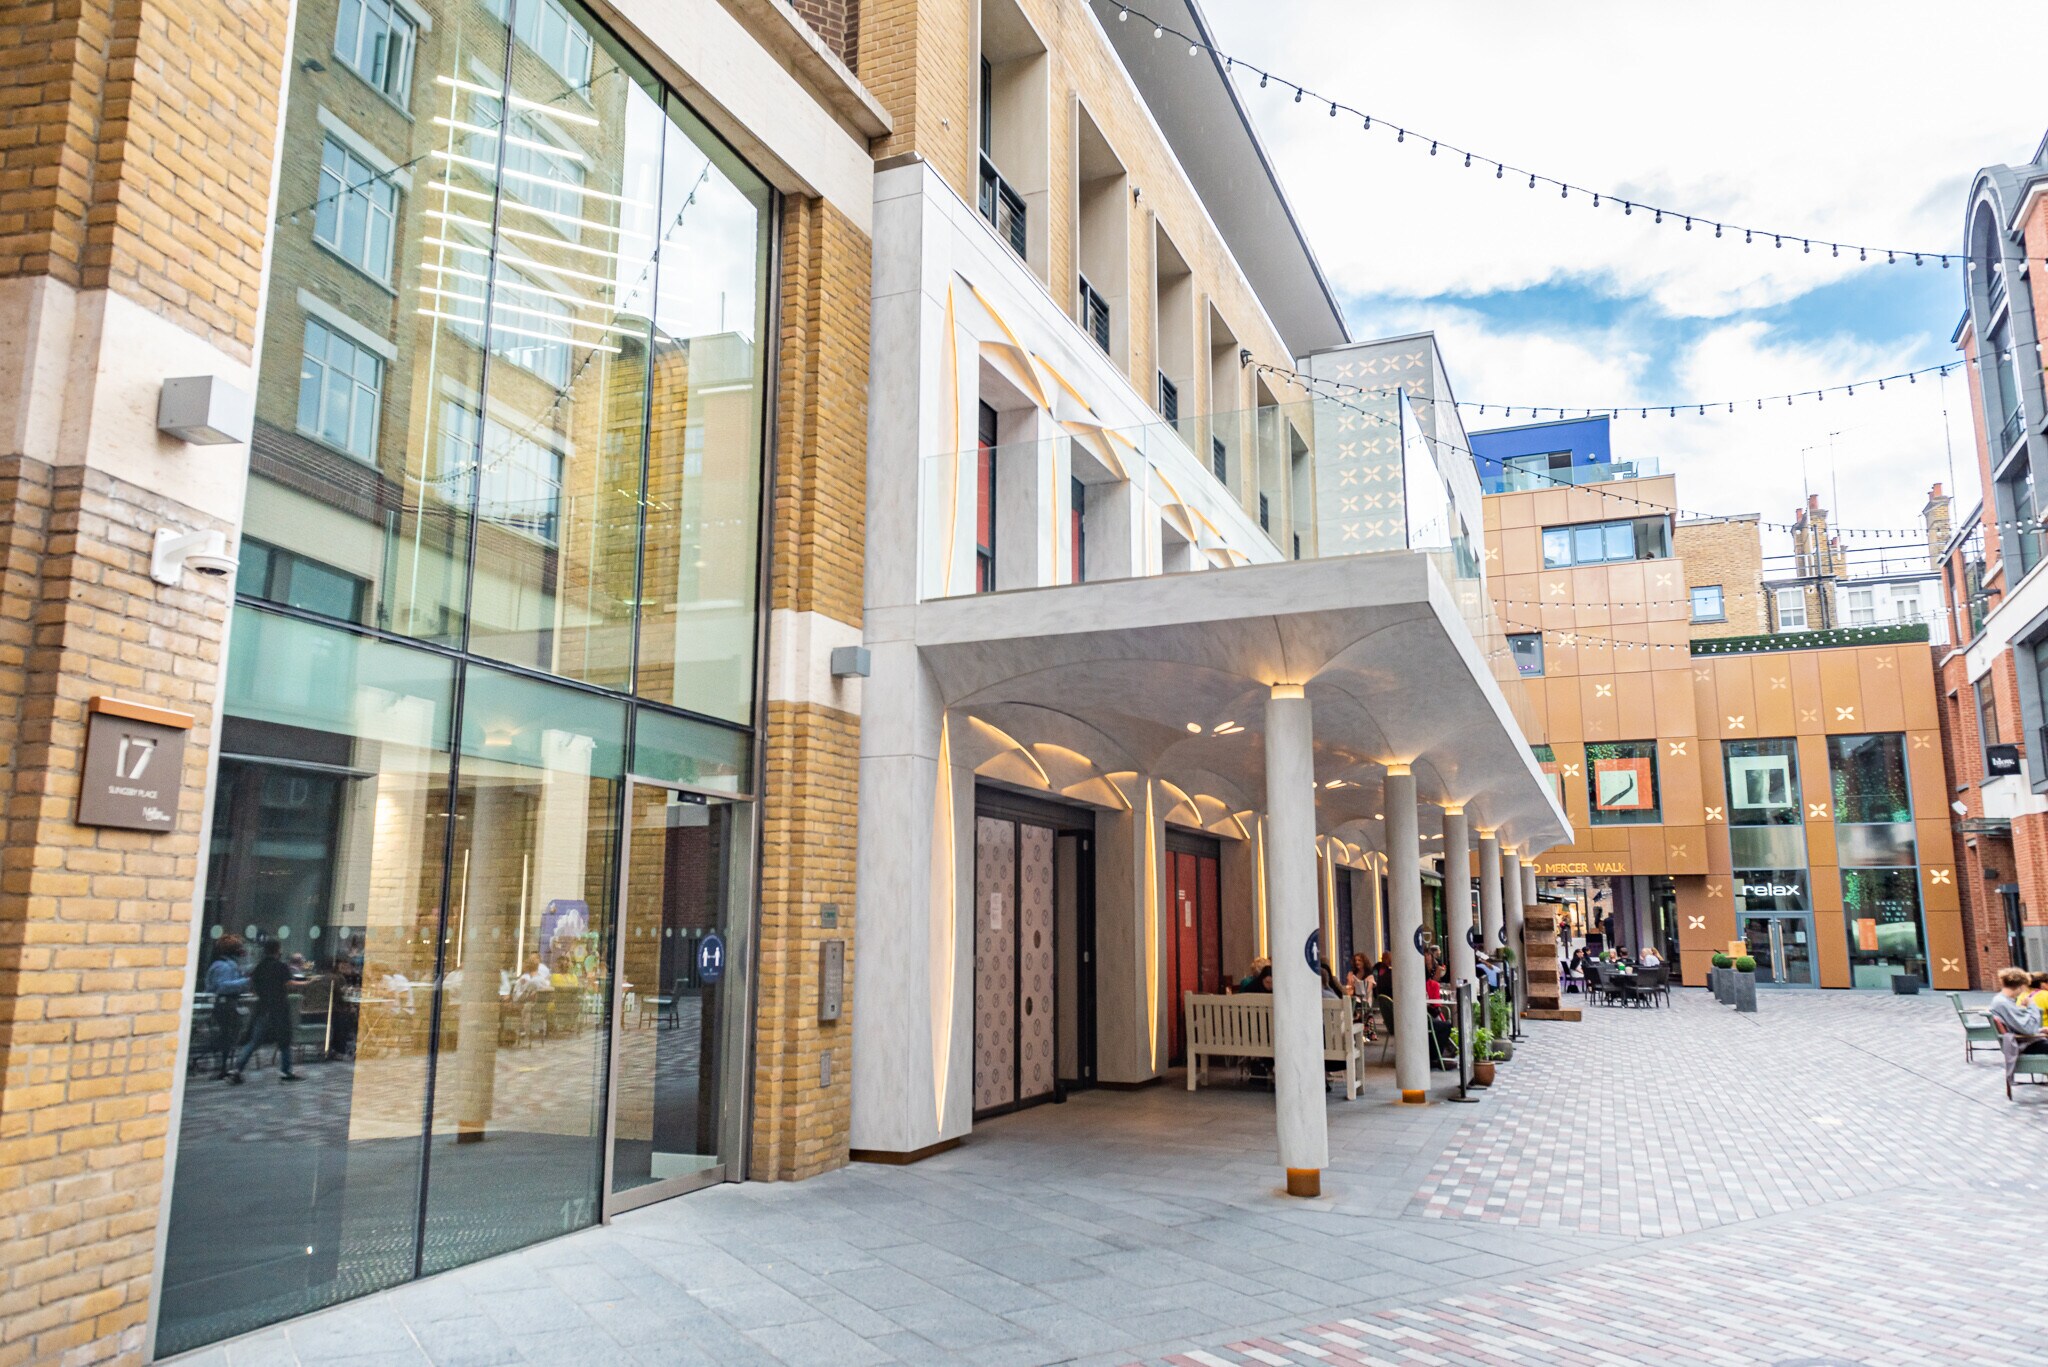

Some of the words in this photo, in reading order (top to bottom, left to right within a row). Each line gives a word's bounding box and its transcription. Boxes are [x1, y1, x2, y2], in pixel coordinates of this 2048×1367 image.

[115, 734, 158, 780] 17
[138, 789, 158, 800] PLACE
[1545, 862, 1589, 874] MERCER
[1594, 862, 1627, 873] WALK
[1741, 882, 1800, 897] relax
